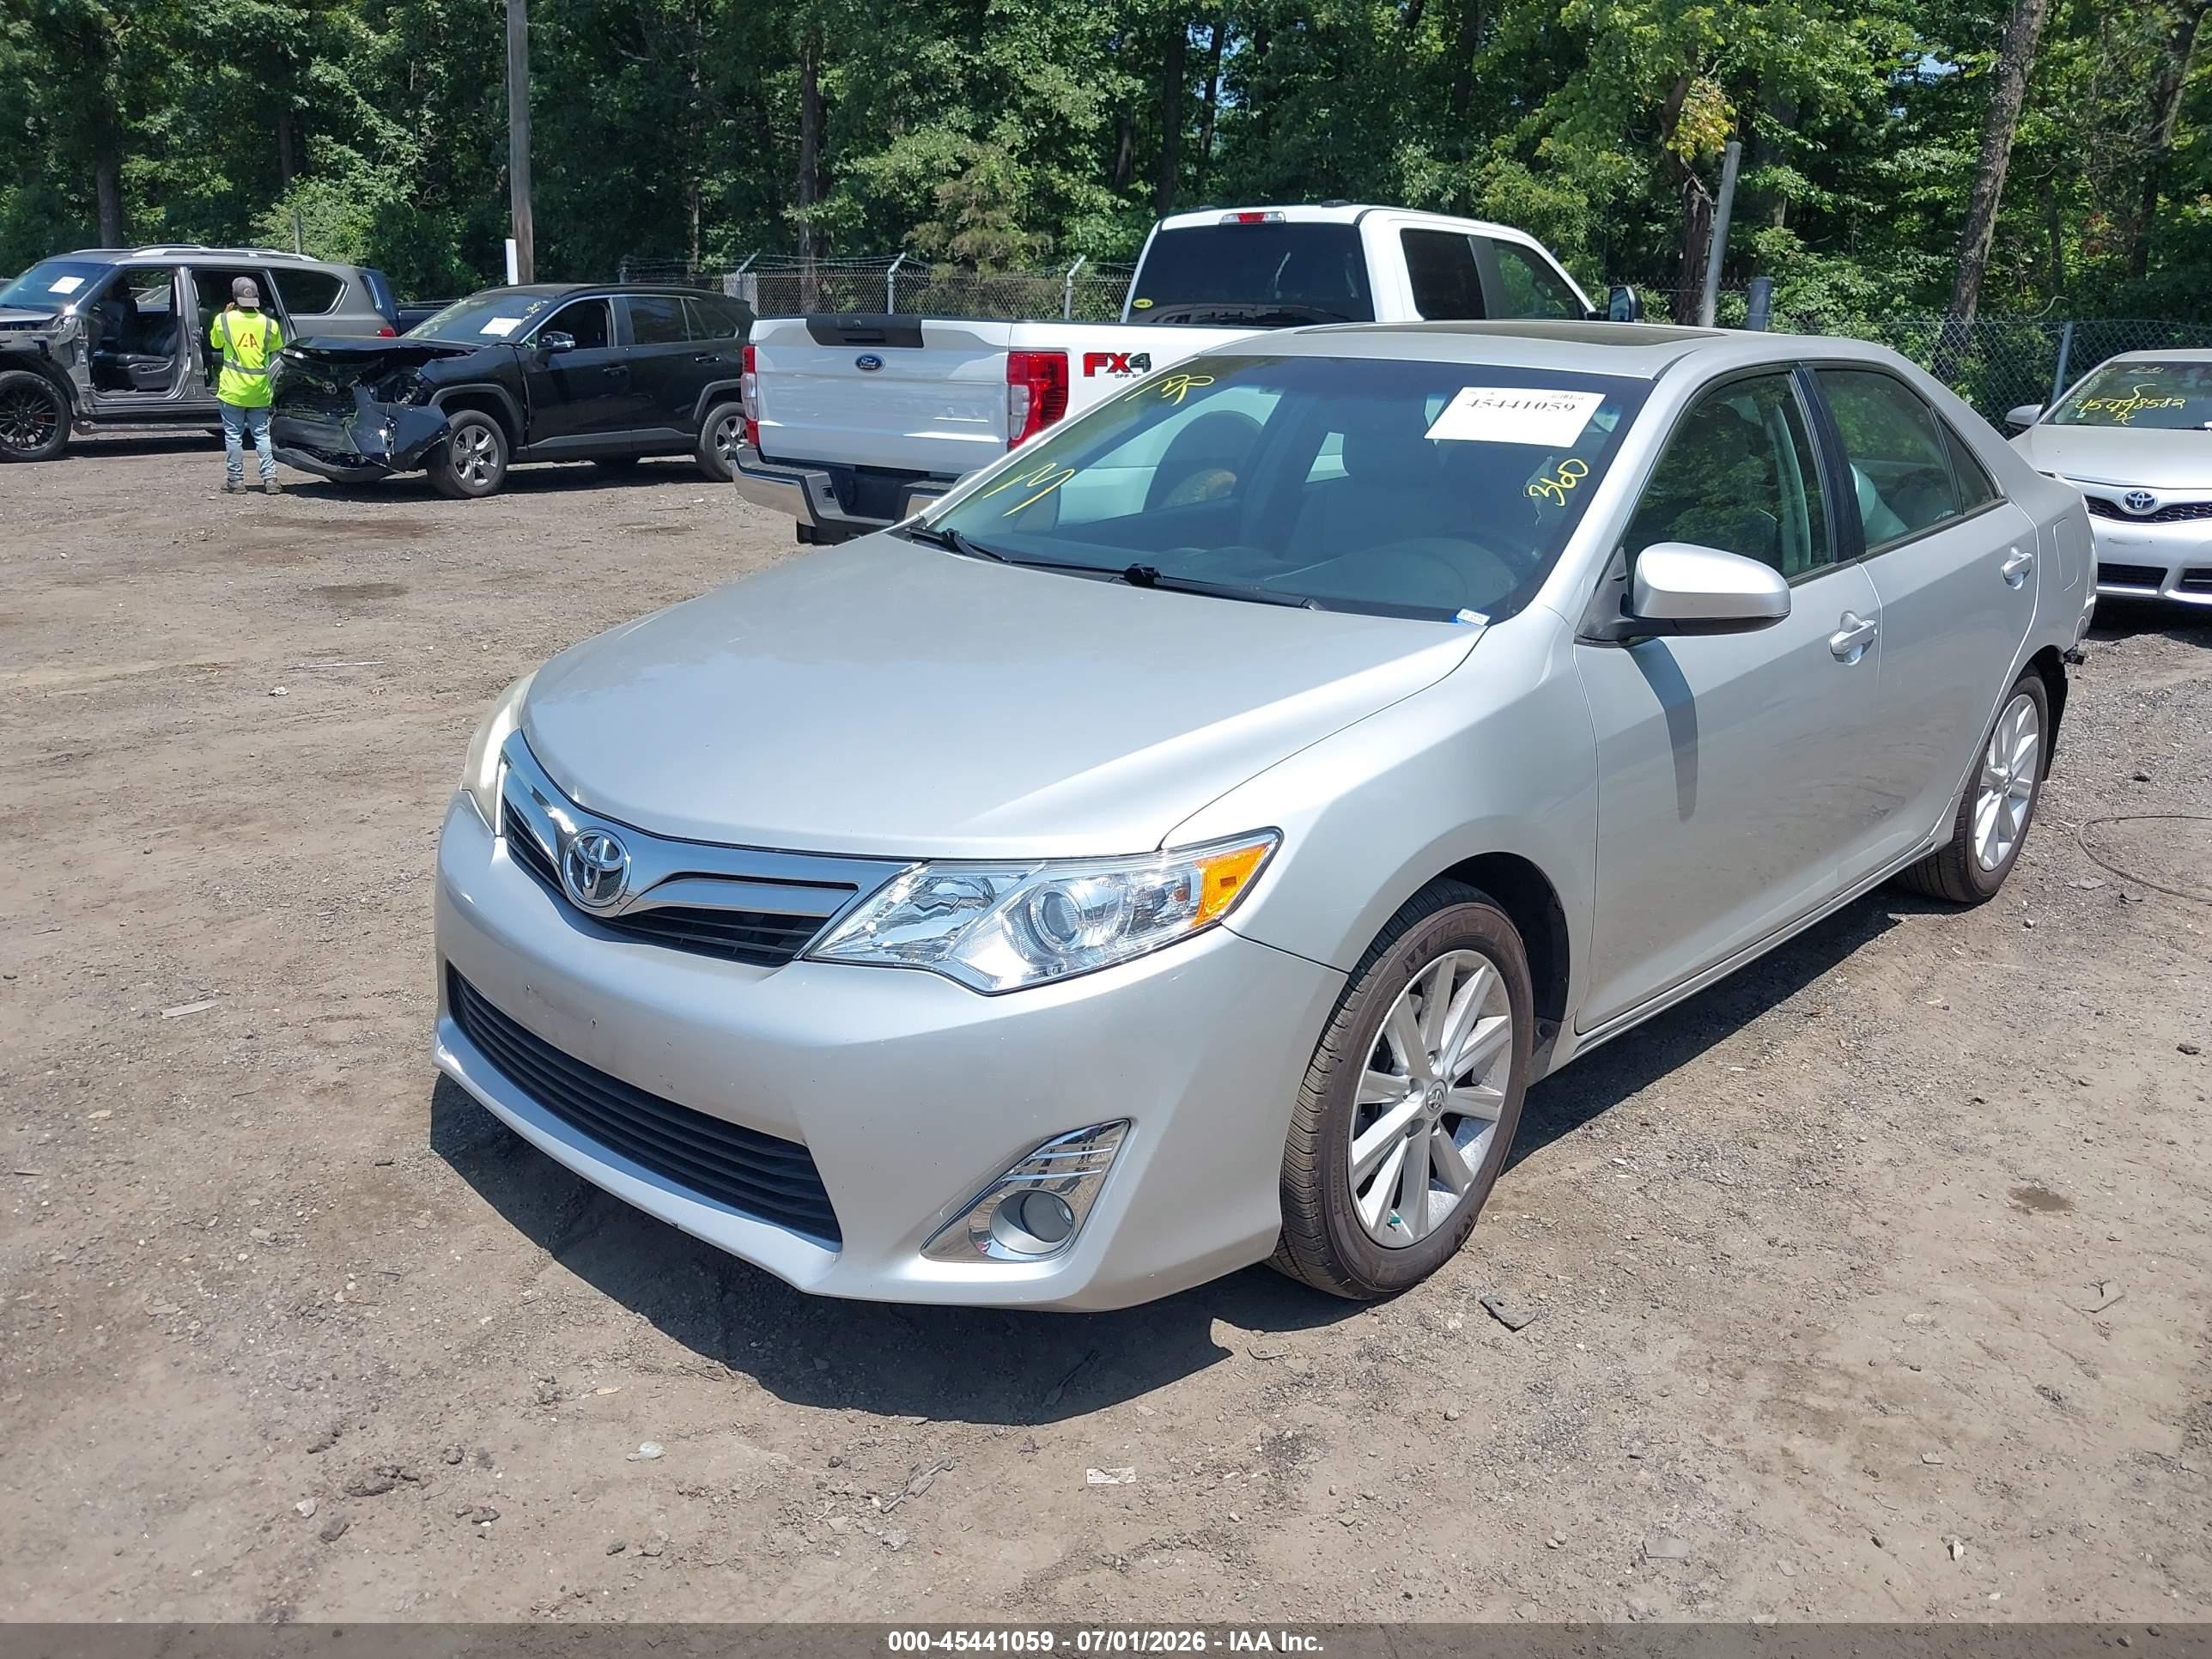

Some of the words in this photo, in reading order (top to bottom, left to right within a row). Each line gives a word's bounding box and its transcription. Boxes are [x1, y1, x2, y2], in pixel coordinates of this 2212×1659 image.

[1083, 352, 1152, 377] FX4
[1467, 398, 1576, 411] 45441059
[2075, 397, 2186, 413] 45498582
[1528, 458, 1589, 507] 360
